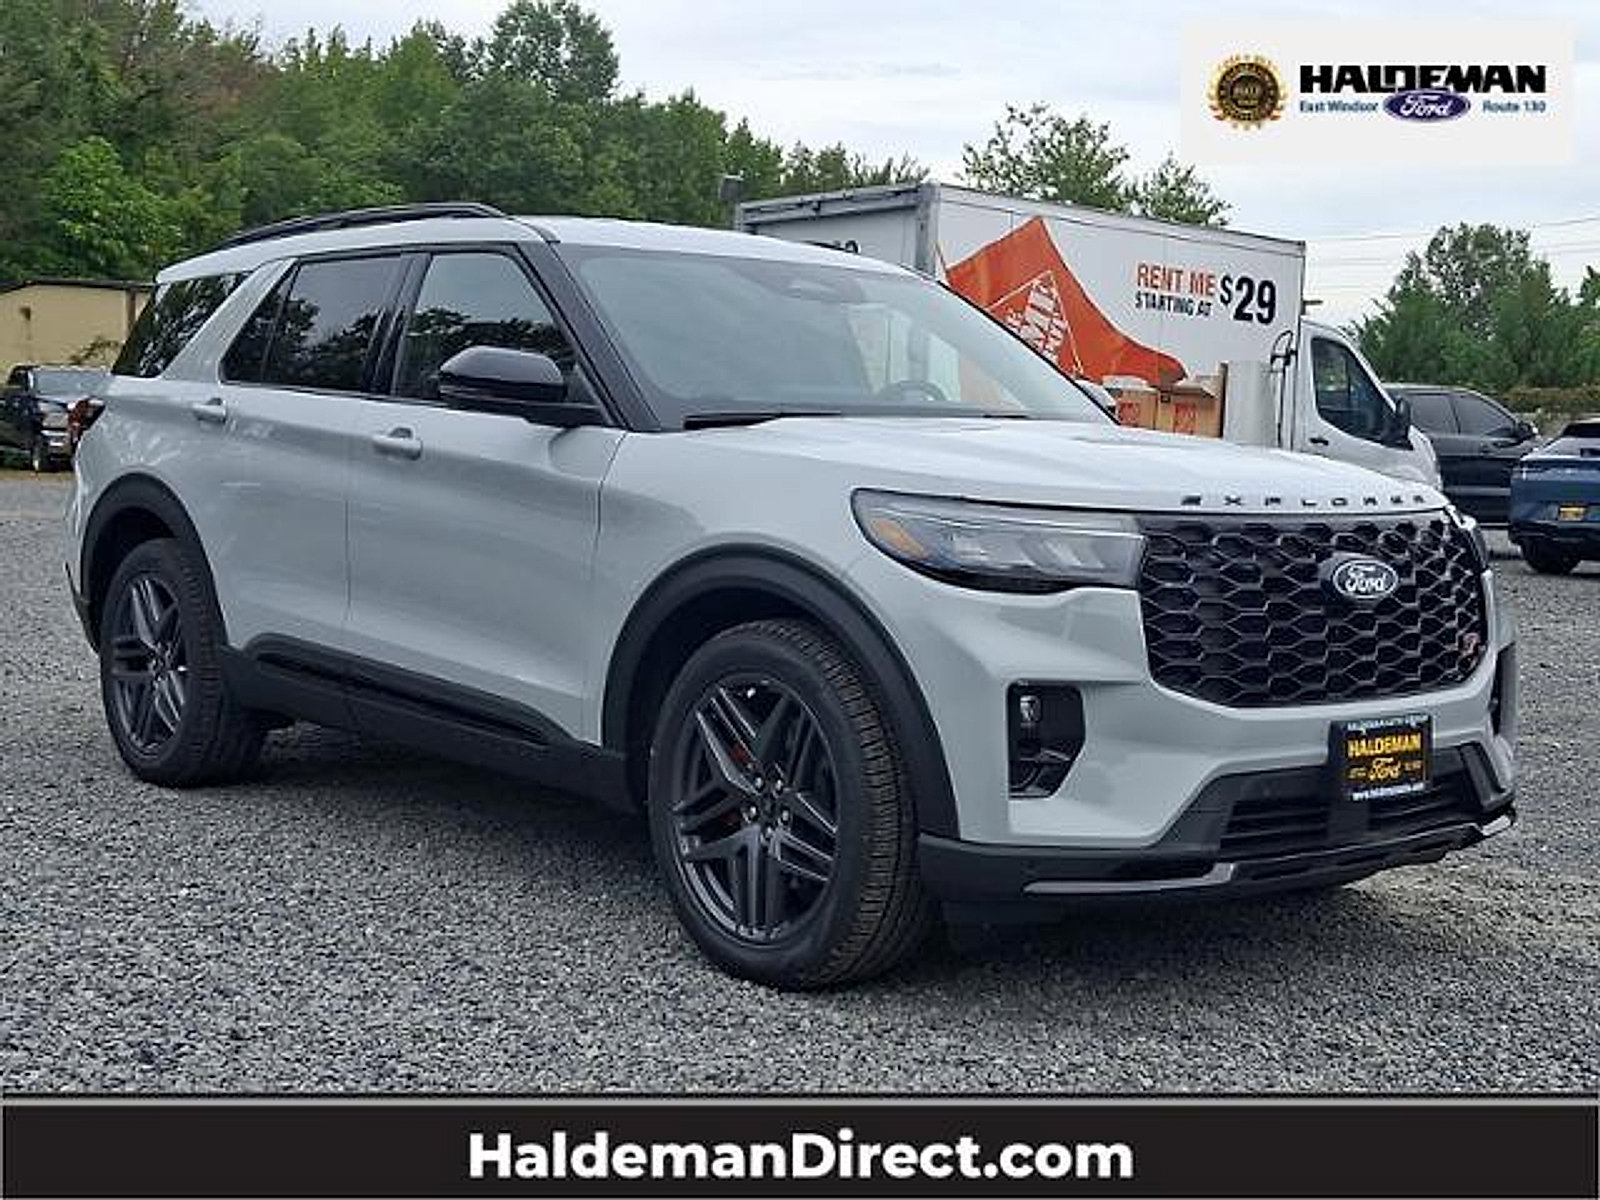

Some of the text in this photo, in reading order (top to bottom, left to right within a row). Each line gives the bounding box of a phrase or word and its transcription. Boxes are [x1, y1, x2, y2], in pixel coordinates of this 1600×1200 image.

[1137, 263, 1215, 296] RENT ME
[1135, 291, 1195, 316] STARTING
[1219, 274, 1277, 324] $29
[1181, 494, 1425, 507] EXPLORER
[1345, 565, 1387, 592] Ford
[1347, 732, 1421, 758] HALDEMAN
[1369, 757, 1401, 781] Ford
